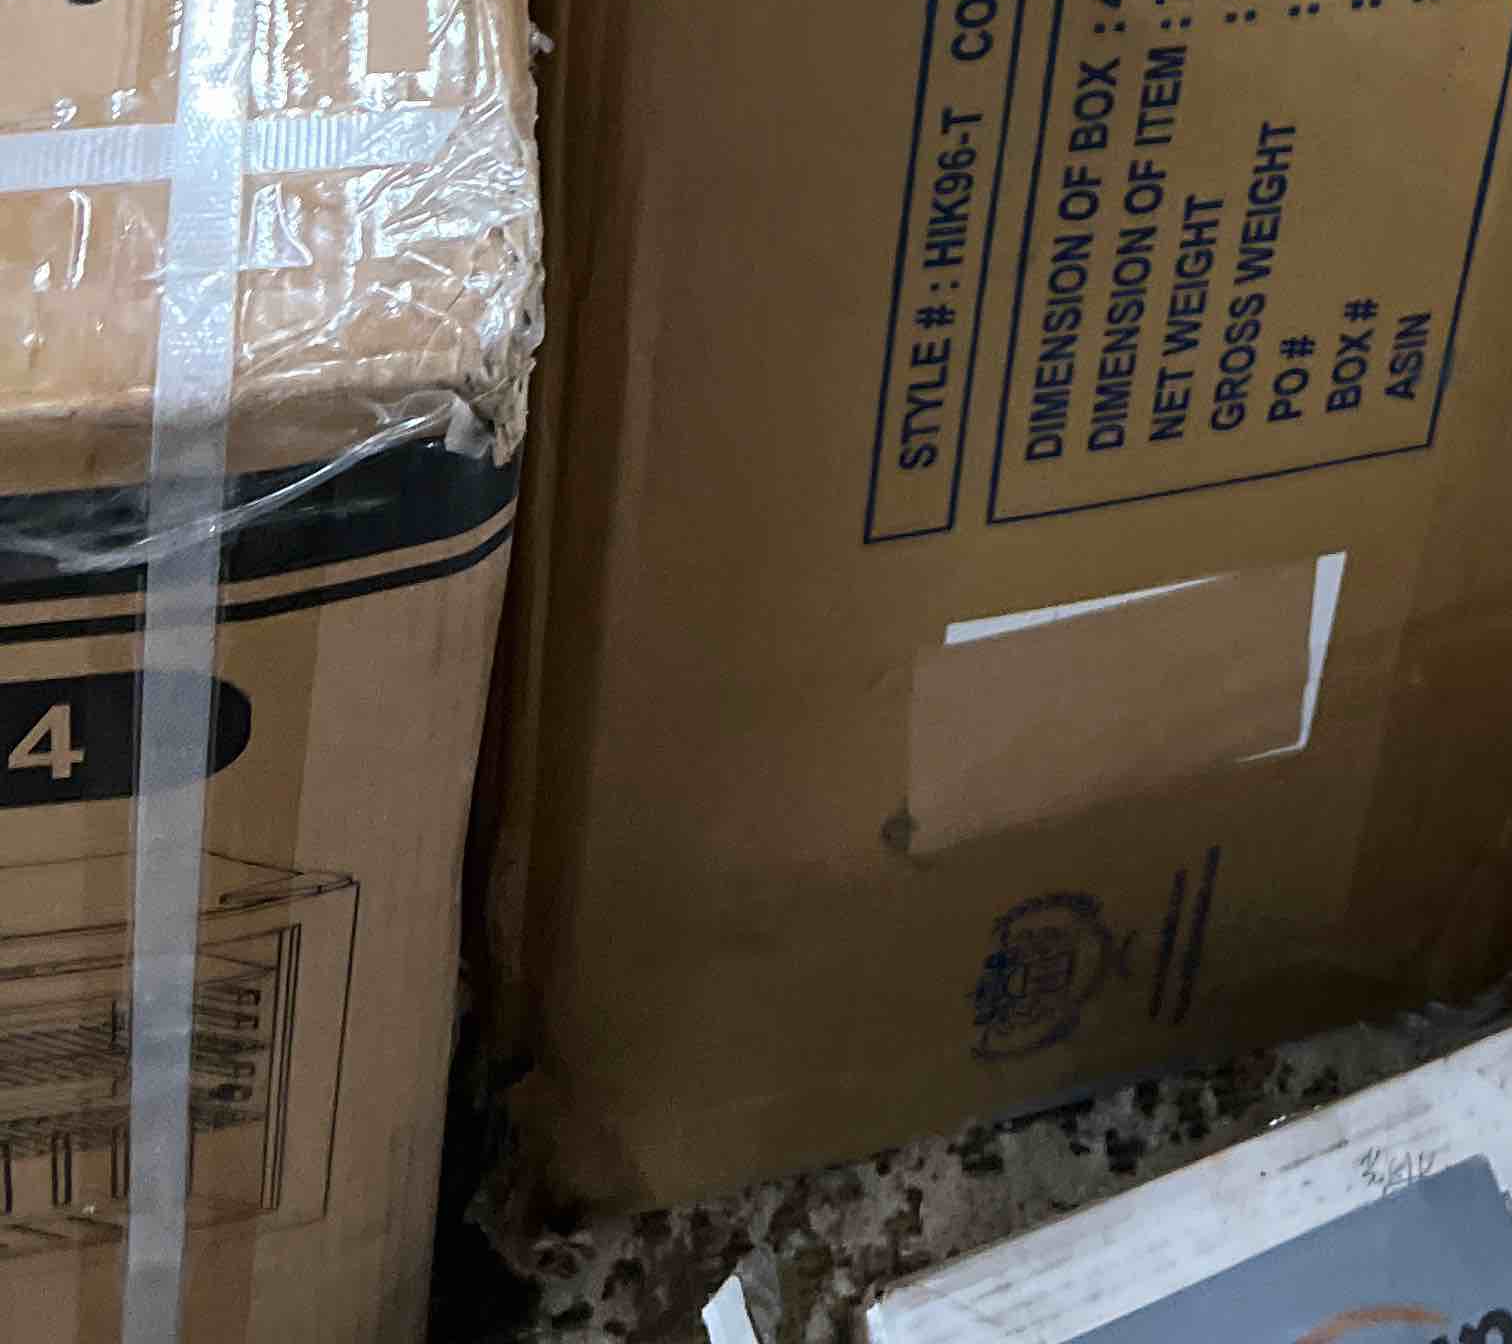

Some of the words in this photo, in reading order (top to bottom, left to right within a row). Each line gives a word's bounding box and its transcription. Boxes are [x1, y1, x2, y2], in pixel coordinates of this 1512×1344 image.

[1068, 57, 1121, 153] BOX
[1133, 45, 1187, 148] ITEM
[922, 106, 984, 270] HIK96-T
[1056, 165, 1102, 222] OF
[1123, 159, 1167, 217] OF
[1233, 120, 1297, 286] WEIGHT
[1162, 193, 1225, 358] WEIGHT
[1023, 233, 1094, 463] DIMENSION
[1086, 225, 1159, 453] DIMENSION
[1207, 292, 1266, 432] GROSS
[1325, 328, 1374, 414] BOX
[1383, 312, 1432, 401] ASIN
[897, 336, 952, 471] STYLE
[1148, 365, 1195, 442] NET
[1266, 366, 1311, 423] PO
[8, 703, 85, 779] 4
